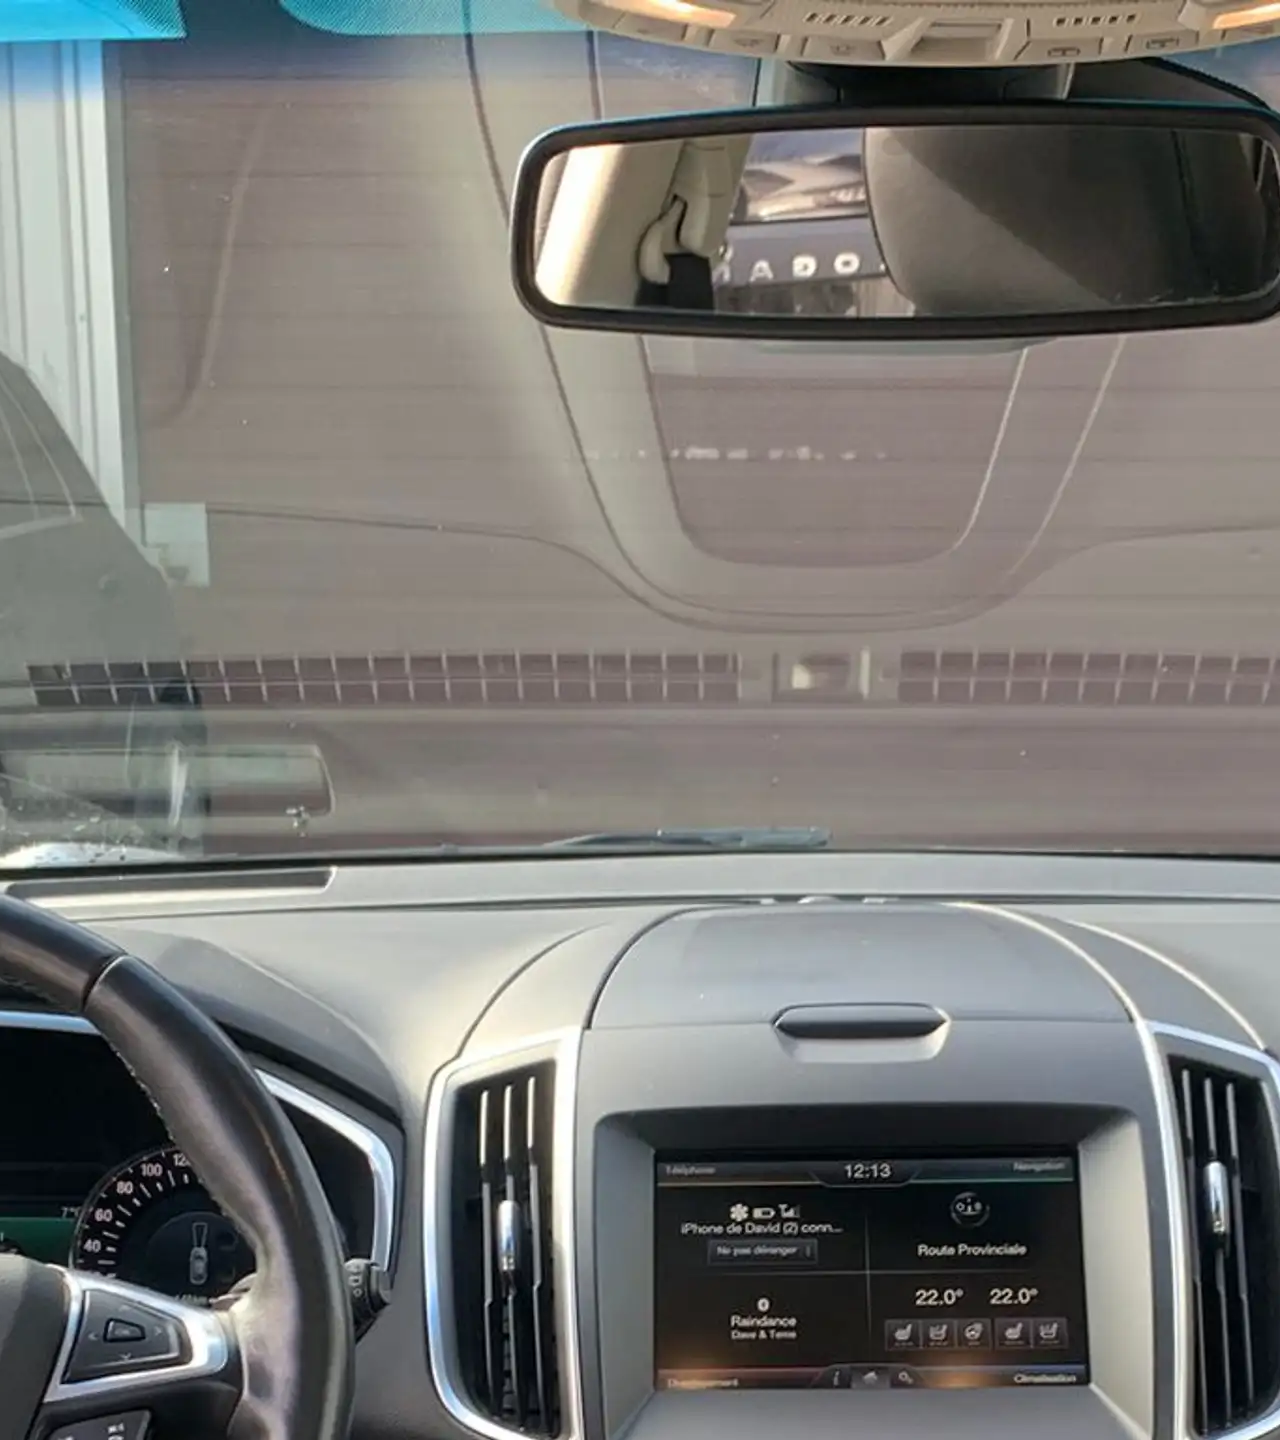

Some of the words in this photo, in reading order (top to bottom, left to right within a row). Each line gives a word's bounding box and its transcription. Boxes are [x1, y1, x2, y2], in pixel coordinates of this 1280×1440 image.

[140, 1162, 163, 1177] 100
[844, 1163, 892, 1179] 12:13
[116, 1180, 134, 1195] 80
[94, 1207, 113, 1222] 60
[681, 1223, 724, 1235] iPhone
[726, 1223, 742, 1235] de
[744, 1222, 780, 1234] David
[83, 1239, 102, 1253] 40
[917, 1243, 956, 1257] Route
[958, 1242, 1028, 1256] Provinciale
[730, 1315, 797, 1328] Raindance
